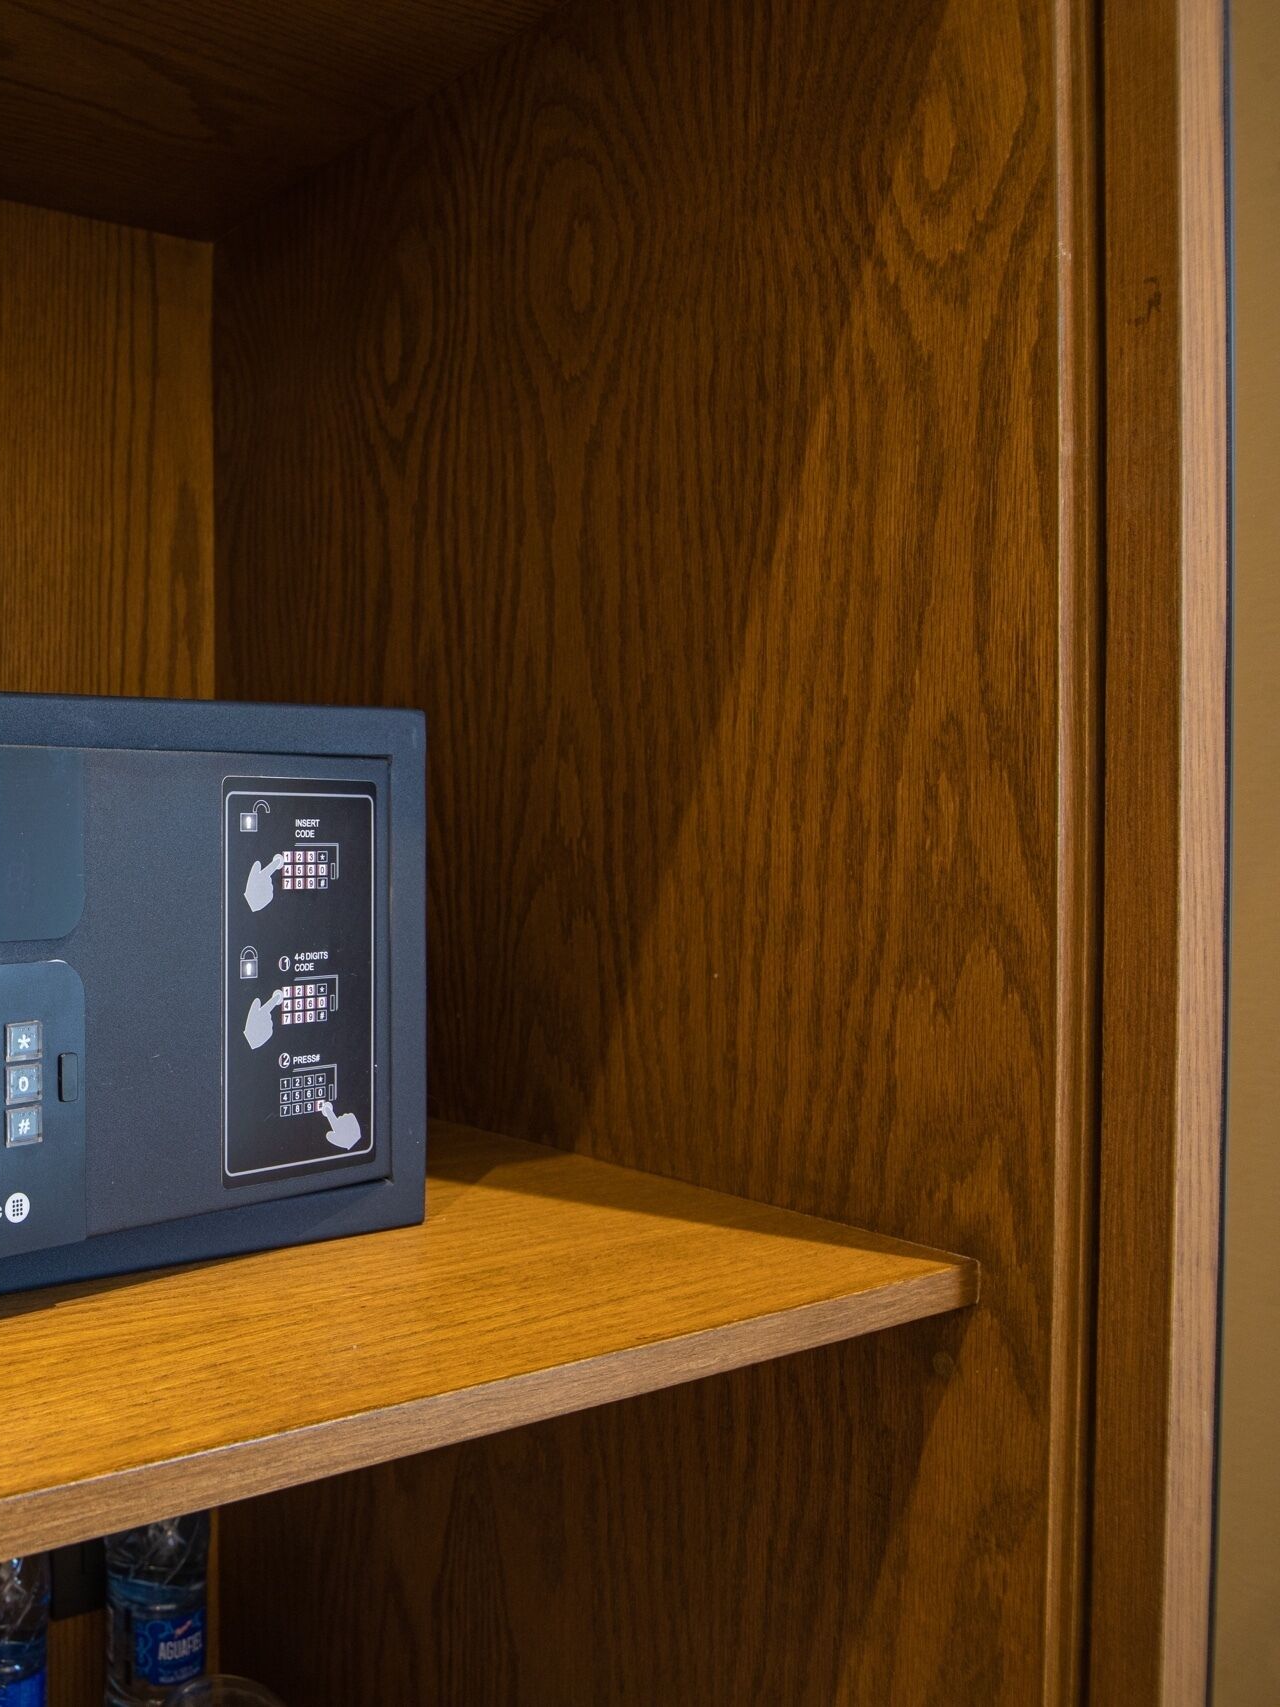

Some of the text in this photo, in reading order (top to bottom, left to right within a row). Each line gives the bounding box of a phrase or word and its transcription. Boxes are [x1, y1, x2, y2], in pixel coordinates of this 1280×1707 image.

[295, 819, 320, 827] INSERT
[295, 830, 315, 838] CODE
[294, 951, 329, 961] 4-6 DIGITS
[294, 963, 315, 972] CODE
[18, 1076, 29, 1092] 0
